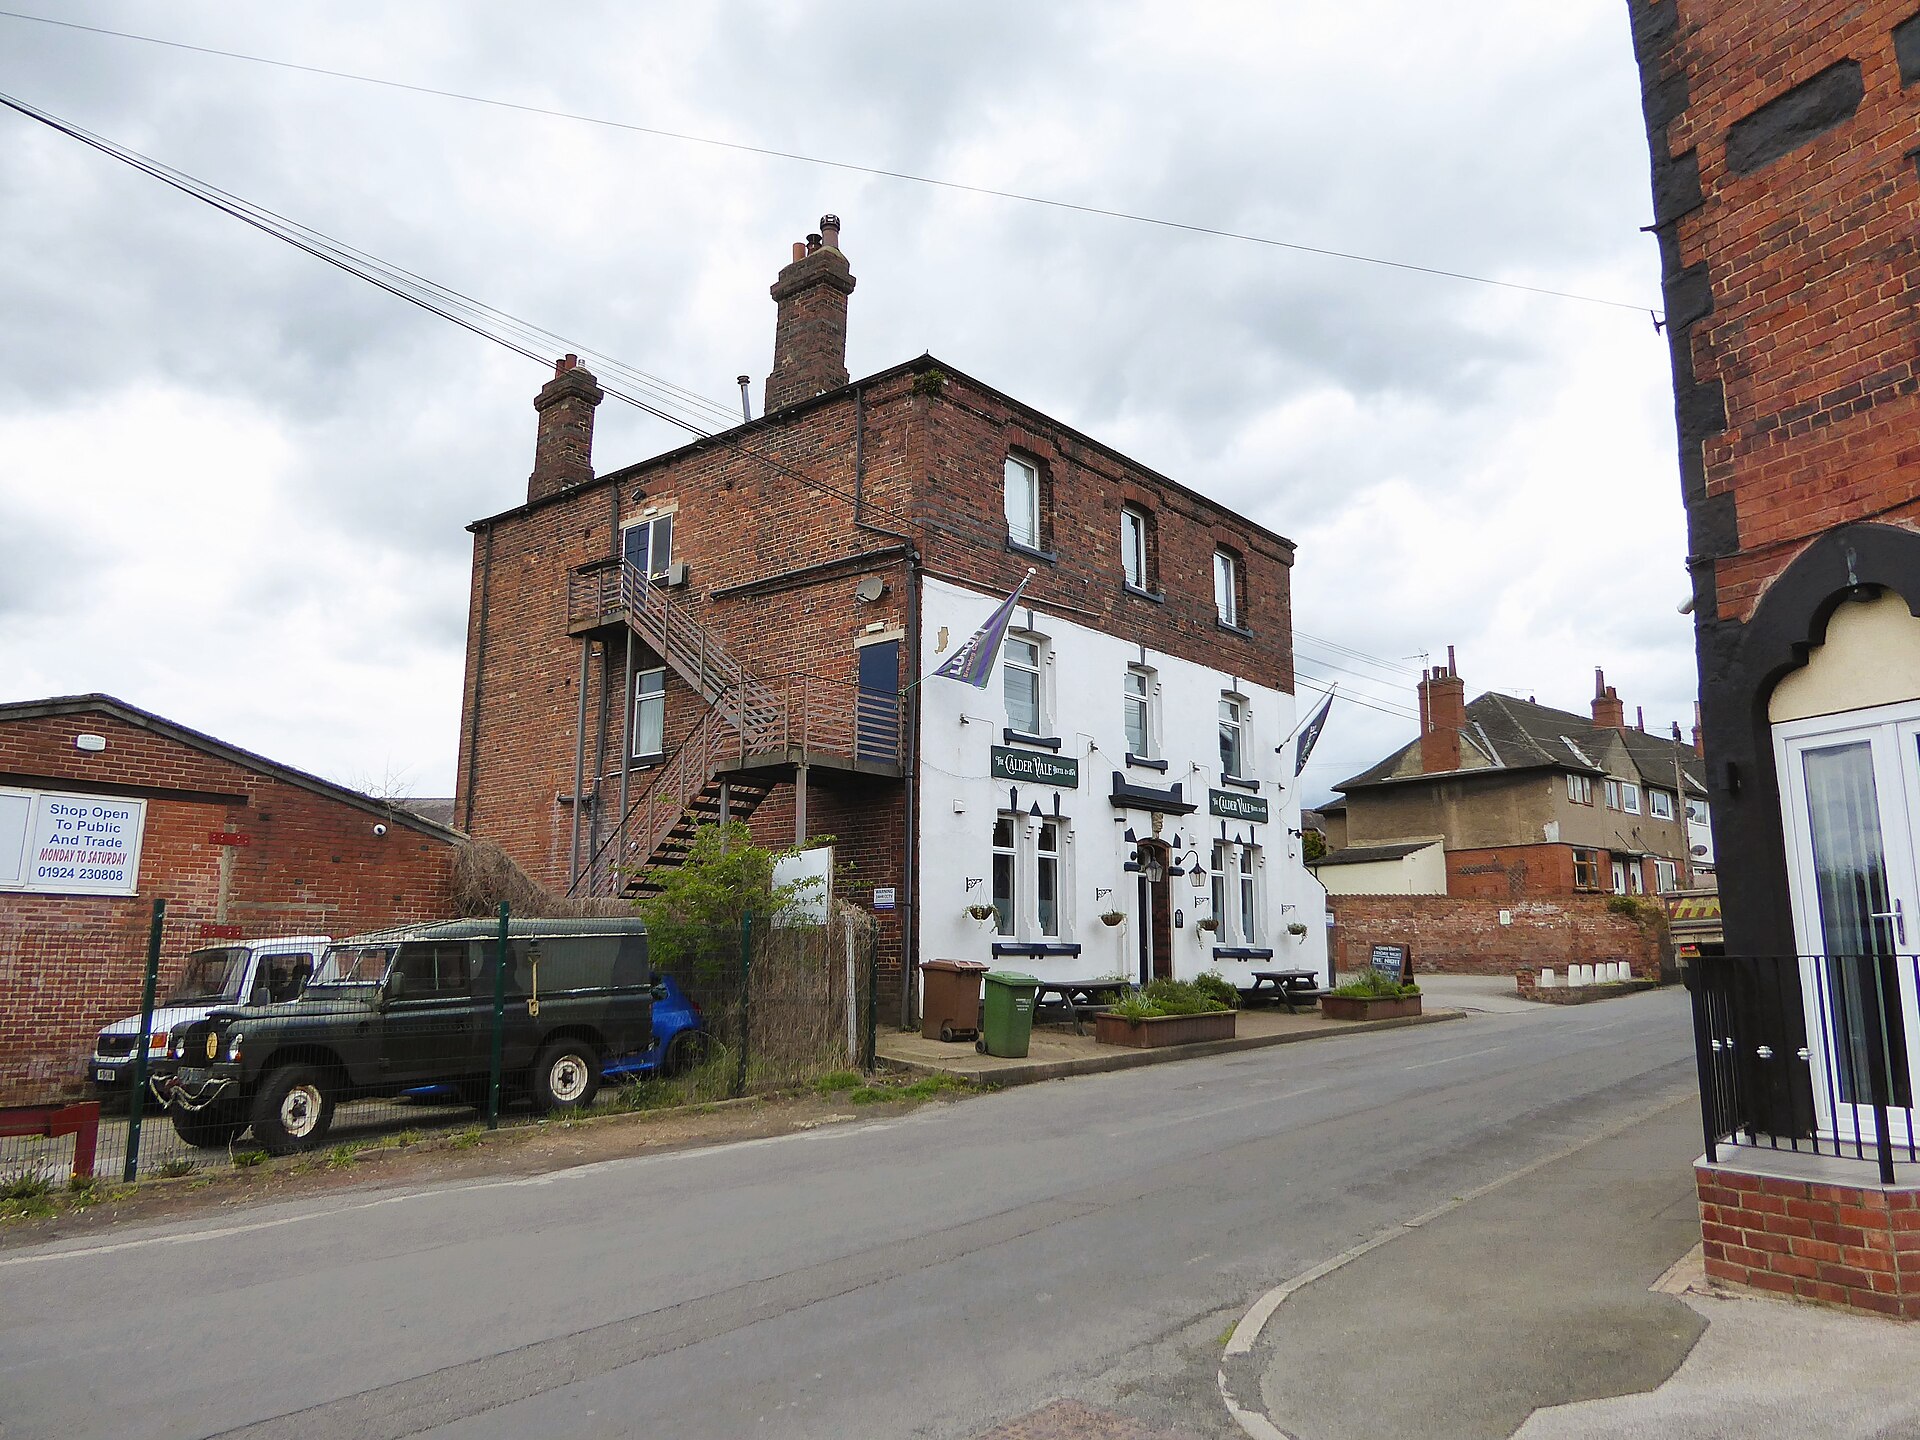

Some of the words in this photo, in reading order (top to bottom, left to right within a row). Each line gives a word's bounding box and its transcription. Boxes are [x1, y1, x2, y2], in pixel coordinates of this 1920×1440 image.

[963, 651, 977, 678] Brewing
[1004, 754, 1033, 775] CALDER
[1032, 756, 1052, 779] VALE
[50, 803, 88, 818] Shop
[92, 807, 129, 820] Open
[1218, 795, 1238, 813] CALDER
[1236, 797, 1251, 815] VALE
[55, 819, 72, 830] To
[77, 820, 121, 833] Public
[49, 834, 79, 845] And
[84, 835, 123, 847] Trade
[39, 848, 75, 862] MONDAY
[76, 850, 87, 863] TO
[87, 850, 128, 865] SATURDAY
[38, 866, 75, 879] 01924
[79, 868, 123, 881] 230808
